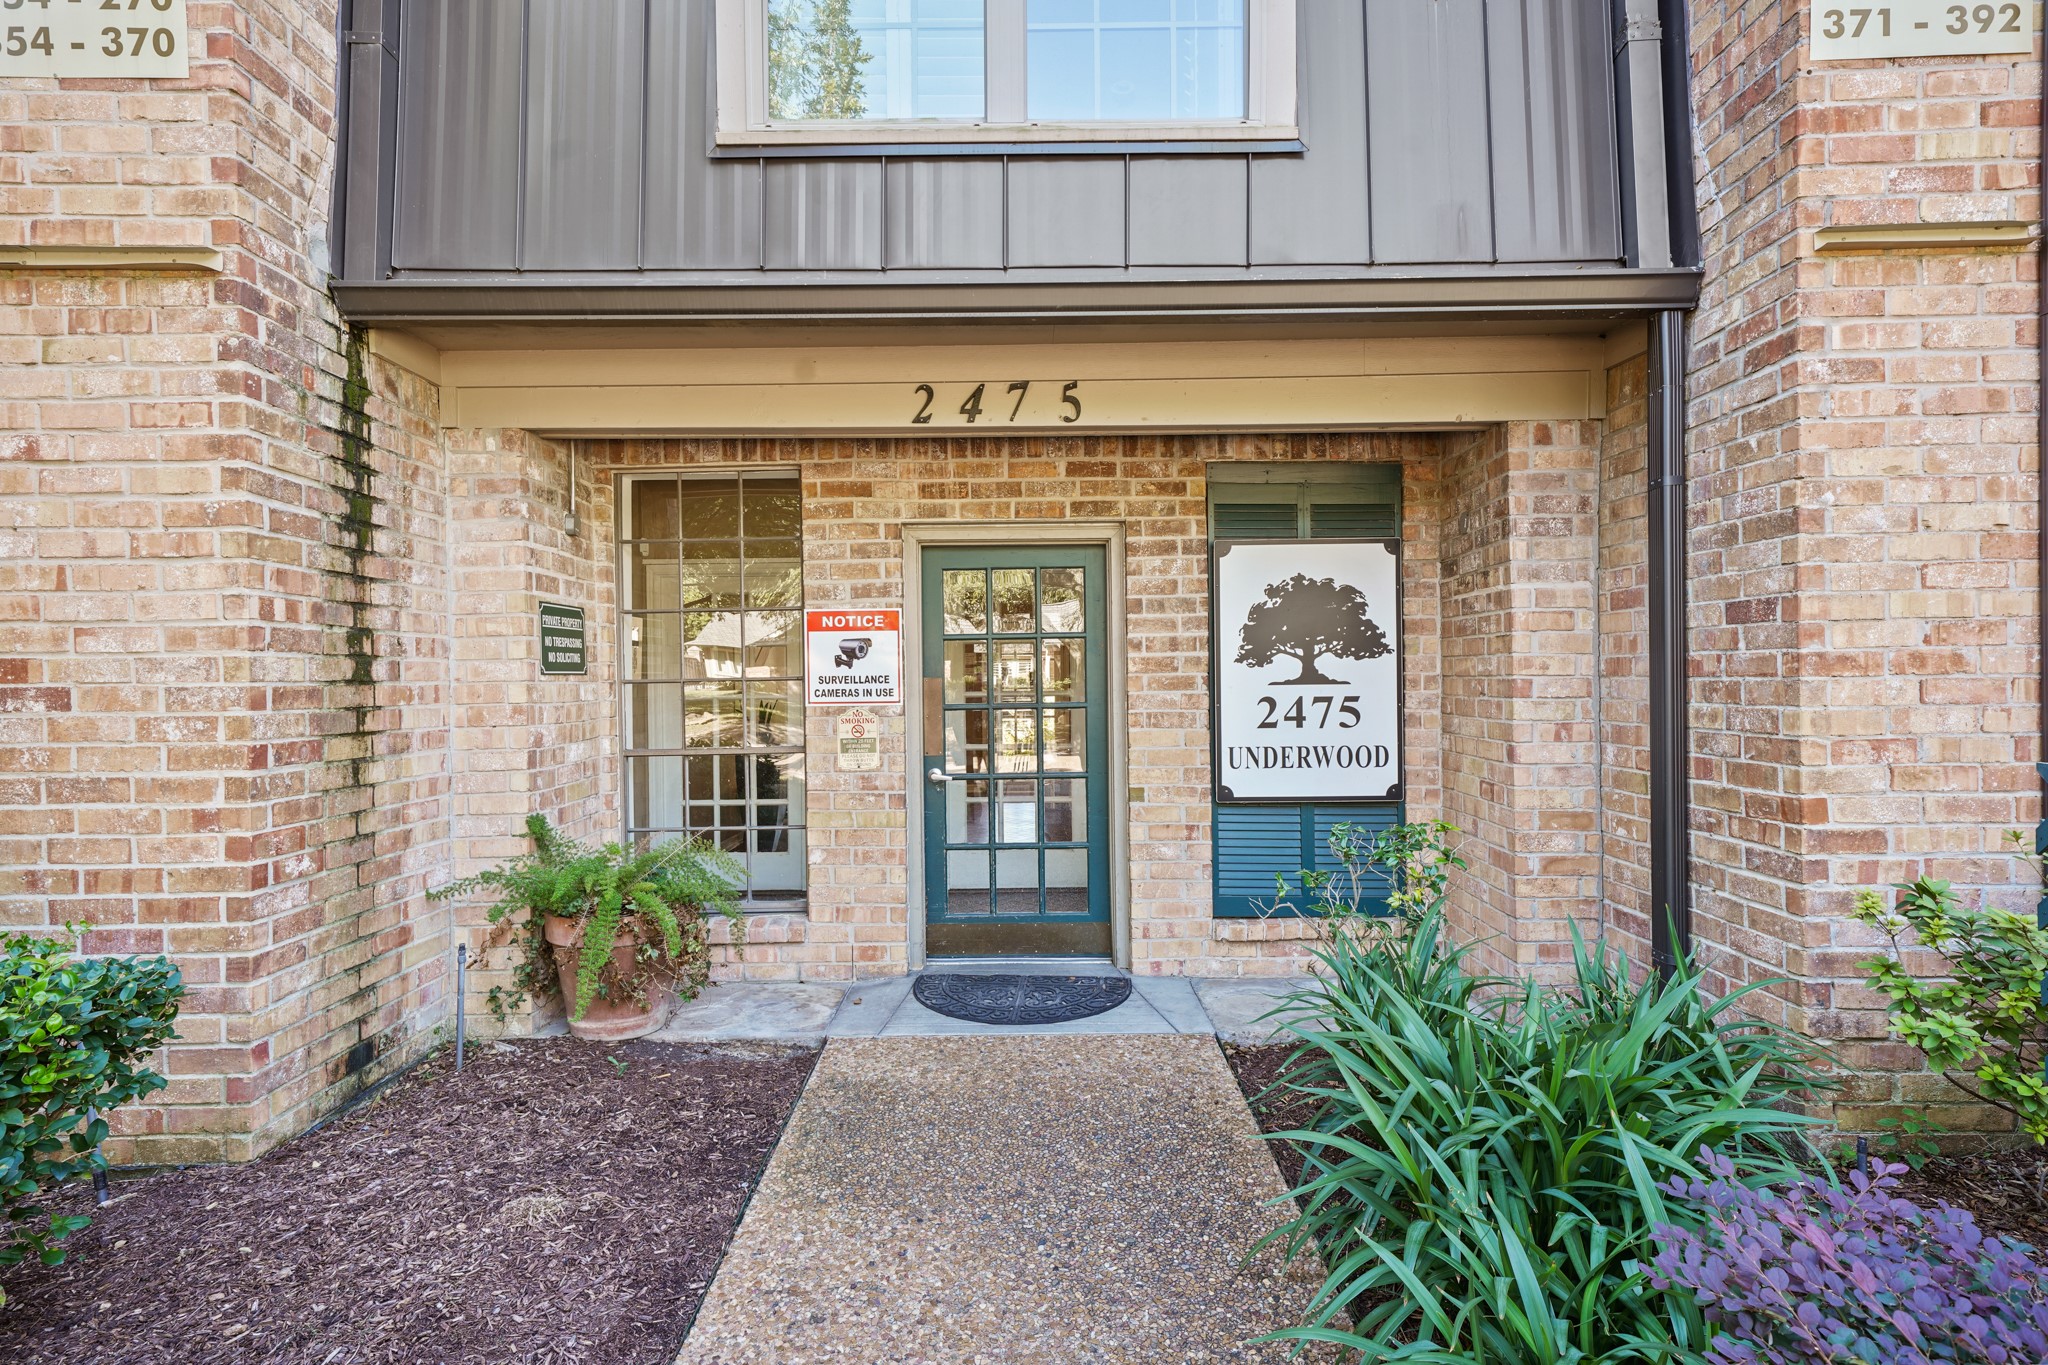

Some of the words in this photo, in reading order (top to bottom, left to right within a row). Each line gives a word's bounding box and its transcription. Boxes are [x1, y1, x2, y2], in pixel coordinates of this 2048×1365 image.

[1822, 8, 1891, 39] 371
[1946, 3, 2021, 34] 392
[0, 26, 54, 56] 54
[101, 27, 175, 57] 370
[912, 380, 1081, 424] 2475
[542, 615, 561, 626] PRIVATE
[561, 617, 582, 628] PROPERTY
[821, 616, 884, 627] NOTICE
[545, 636, 552, 647] NO
[553, 637, 582, 649] TRESPASSING
[548, 652, 556, 662] NO
[556, 653, 581, 663] SOLICITING
[818, 675, 890, 684] SURVEILLANCE
[814, 688, 860, 698] CAMERAS
[862, 688, 872, 697] IN
[875, 688, 894, 697] USE
[1257, 696, 1361, 728] 2475
[1228, 745, 1389, 769] UNDERWOOD
